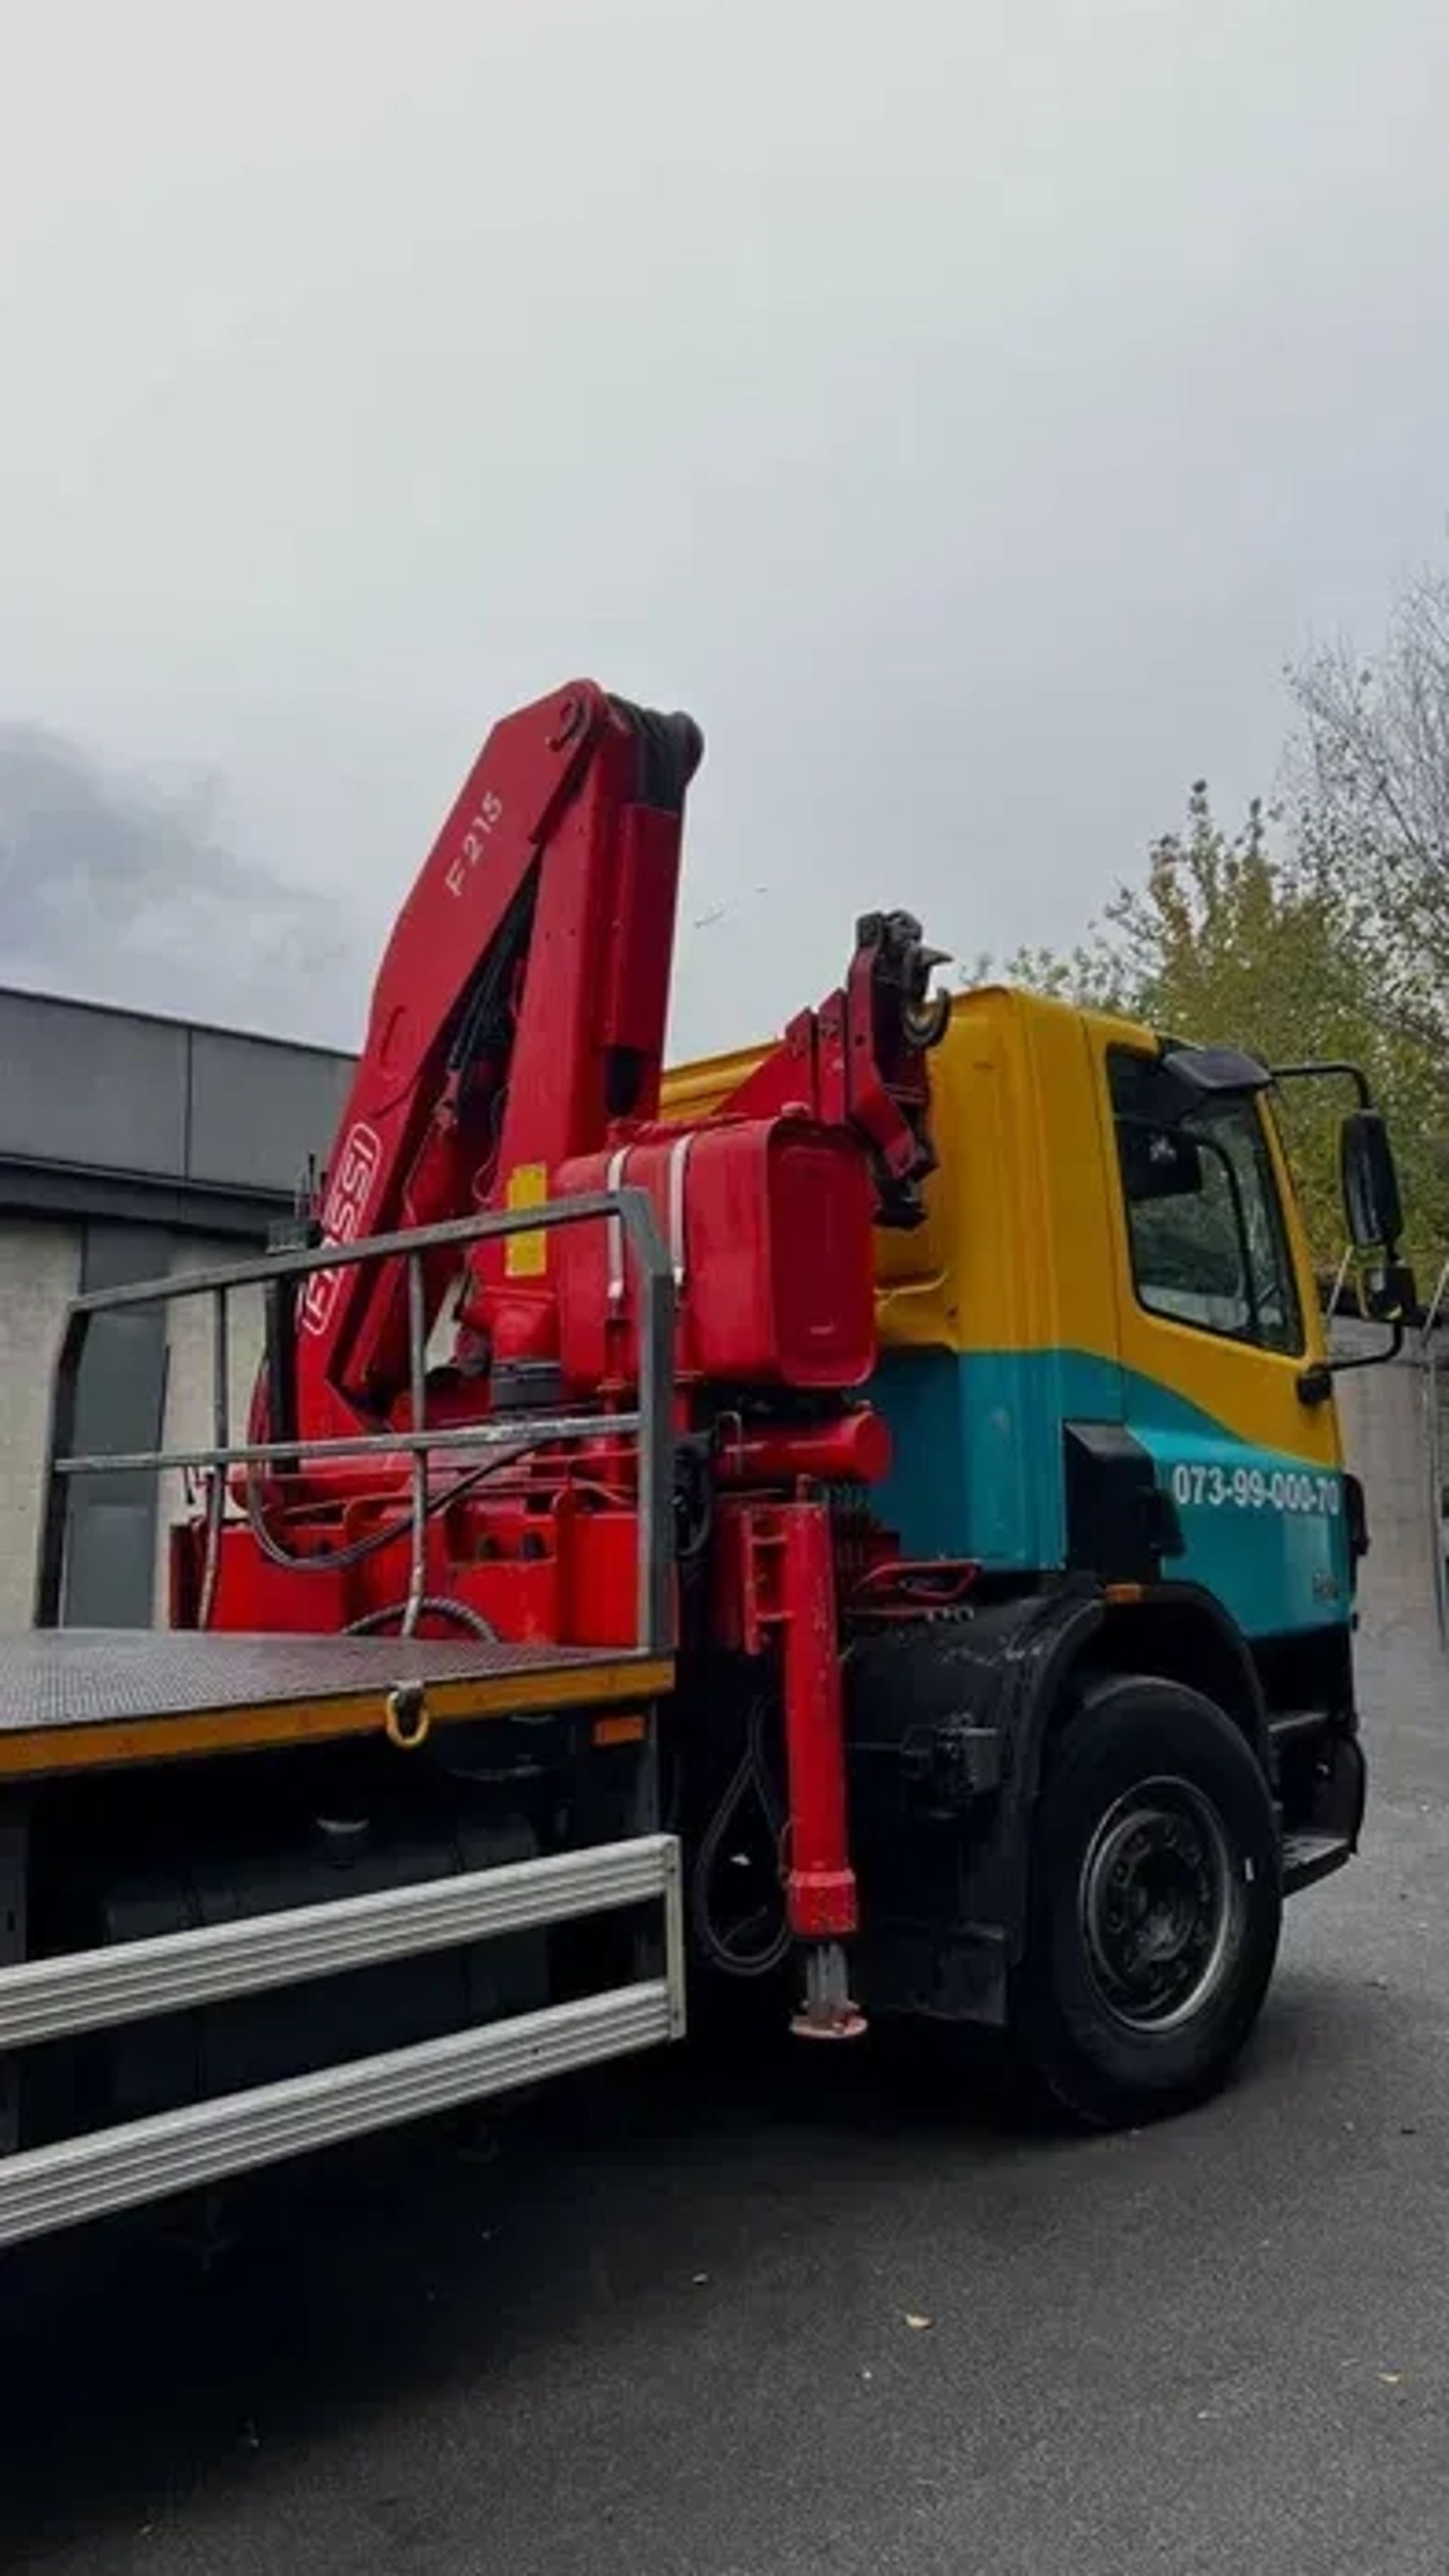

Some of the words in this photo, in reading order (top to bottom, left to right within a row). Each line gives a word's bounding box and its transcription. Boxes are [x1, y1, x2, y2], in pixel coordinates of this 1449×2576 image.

[445, 858, 466, 896] F
[463, 790, 503, 865] 215
[1174, 1464, 1340, 1514] 073-99-000-70
